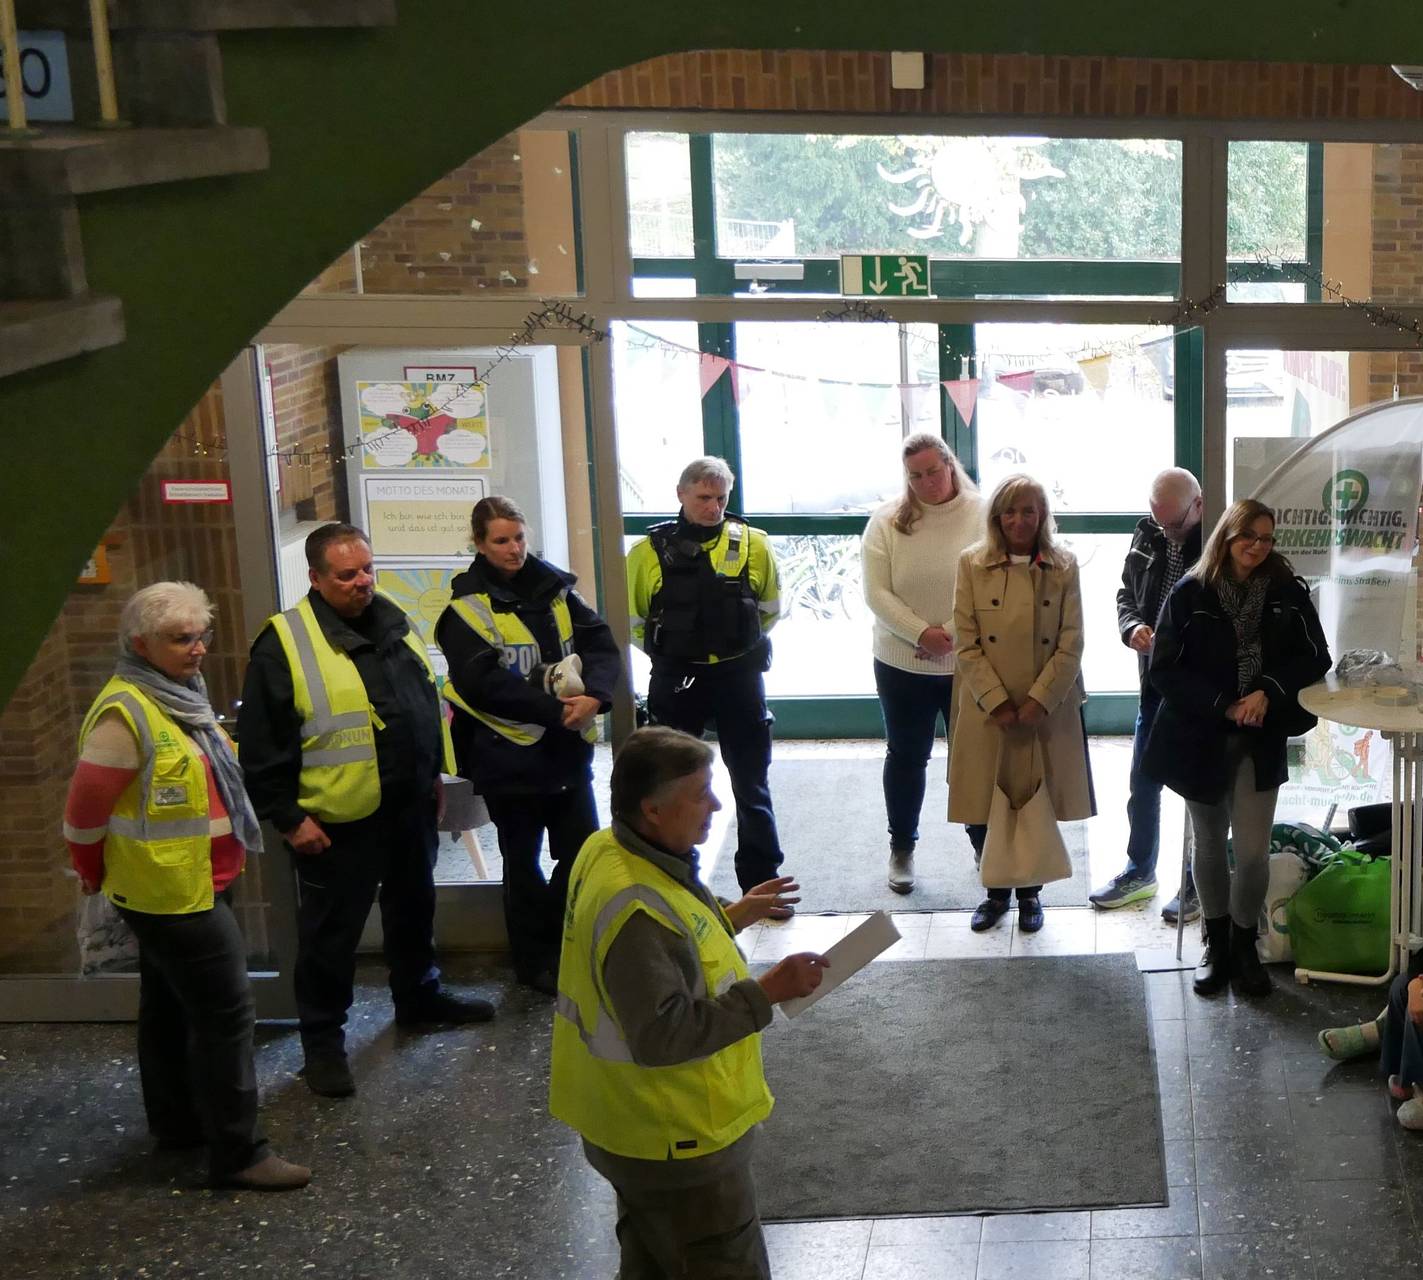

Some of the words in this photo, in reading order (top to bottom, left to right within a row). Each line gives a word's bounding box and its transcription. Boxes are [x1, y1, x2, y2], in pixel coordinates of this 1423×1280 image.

[376, 486, 412, 496] MOTTO
[414, 486, 434, 496] DES
[436, 485, 477, 496] MONATS
[383, 511, 397, 520] Ich
[388, 524, 406, 532] und
[408, 524, 426, 532] das
